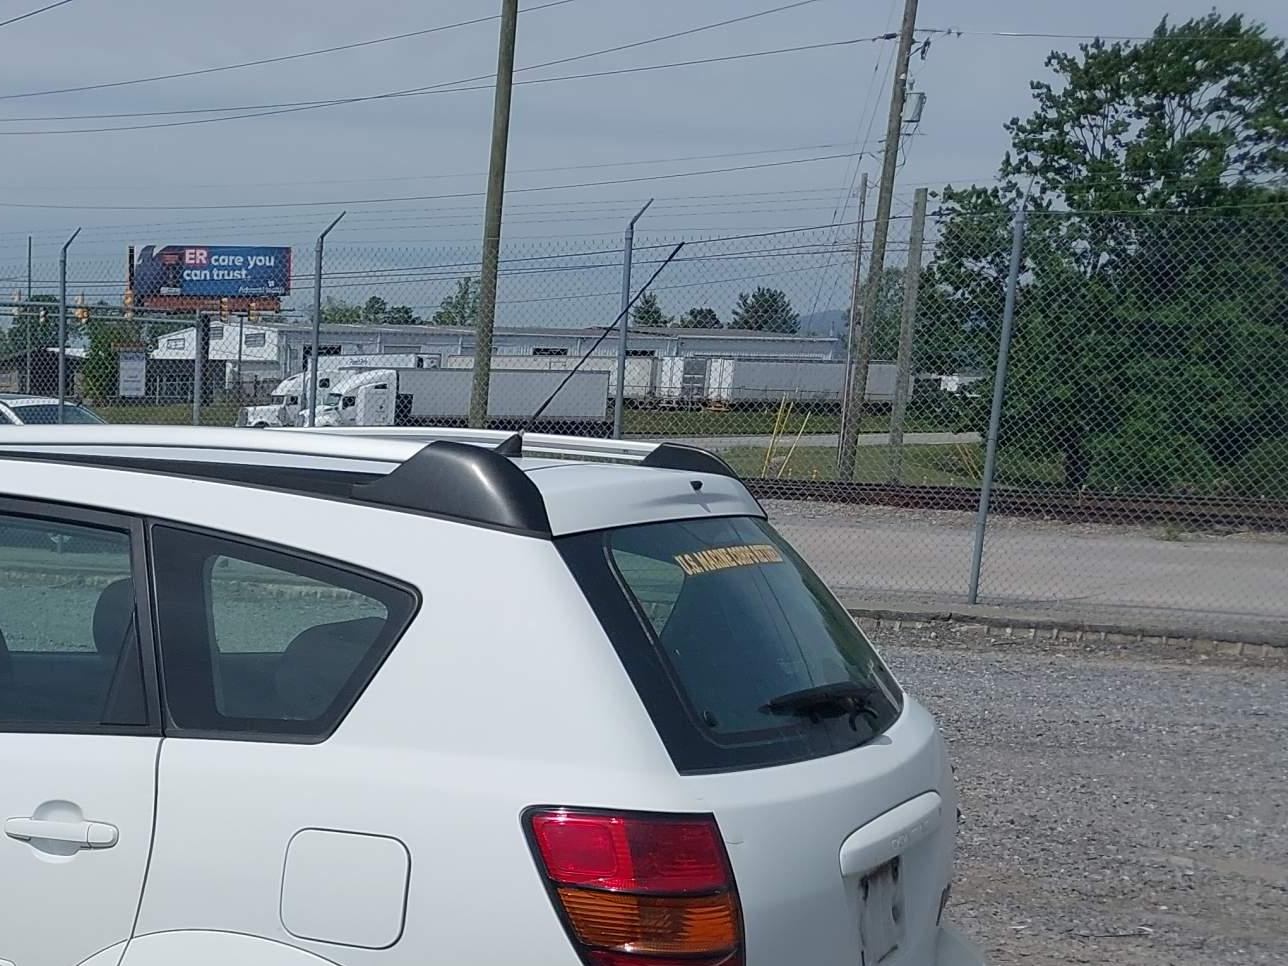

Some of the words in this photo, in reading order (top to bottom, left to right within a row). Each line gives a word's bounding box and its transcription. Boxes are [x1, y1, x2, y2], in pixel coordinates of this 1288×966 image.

[185, 249, 208, 264] ER
[211, 255, 244, 266] care
[247, 255, 274, 269] you
[183, 270, 210, 281] can
[212, 268, 251, 280] trust.
[693, 547, 738, 572] MARINE
